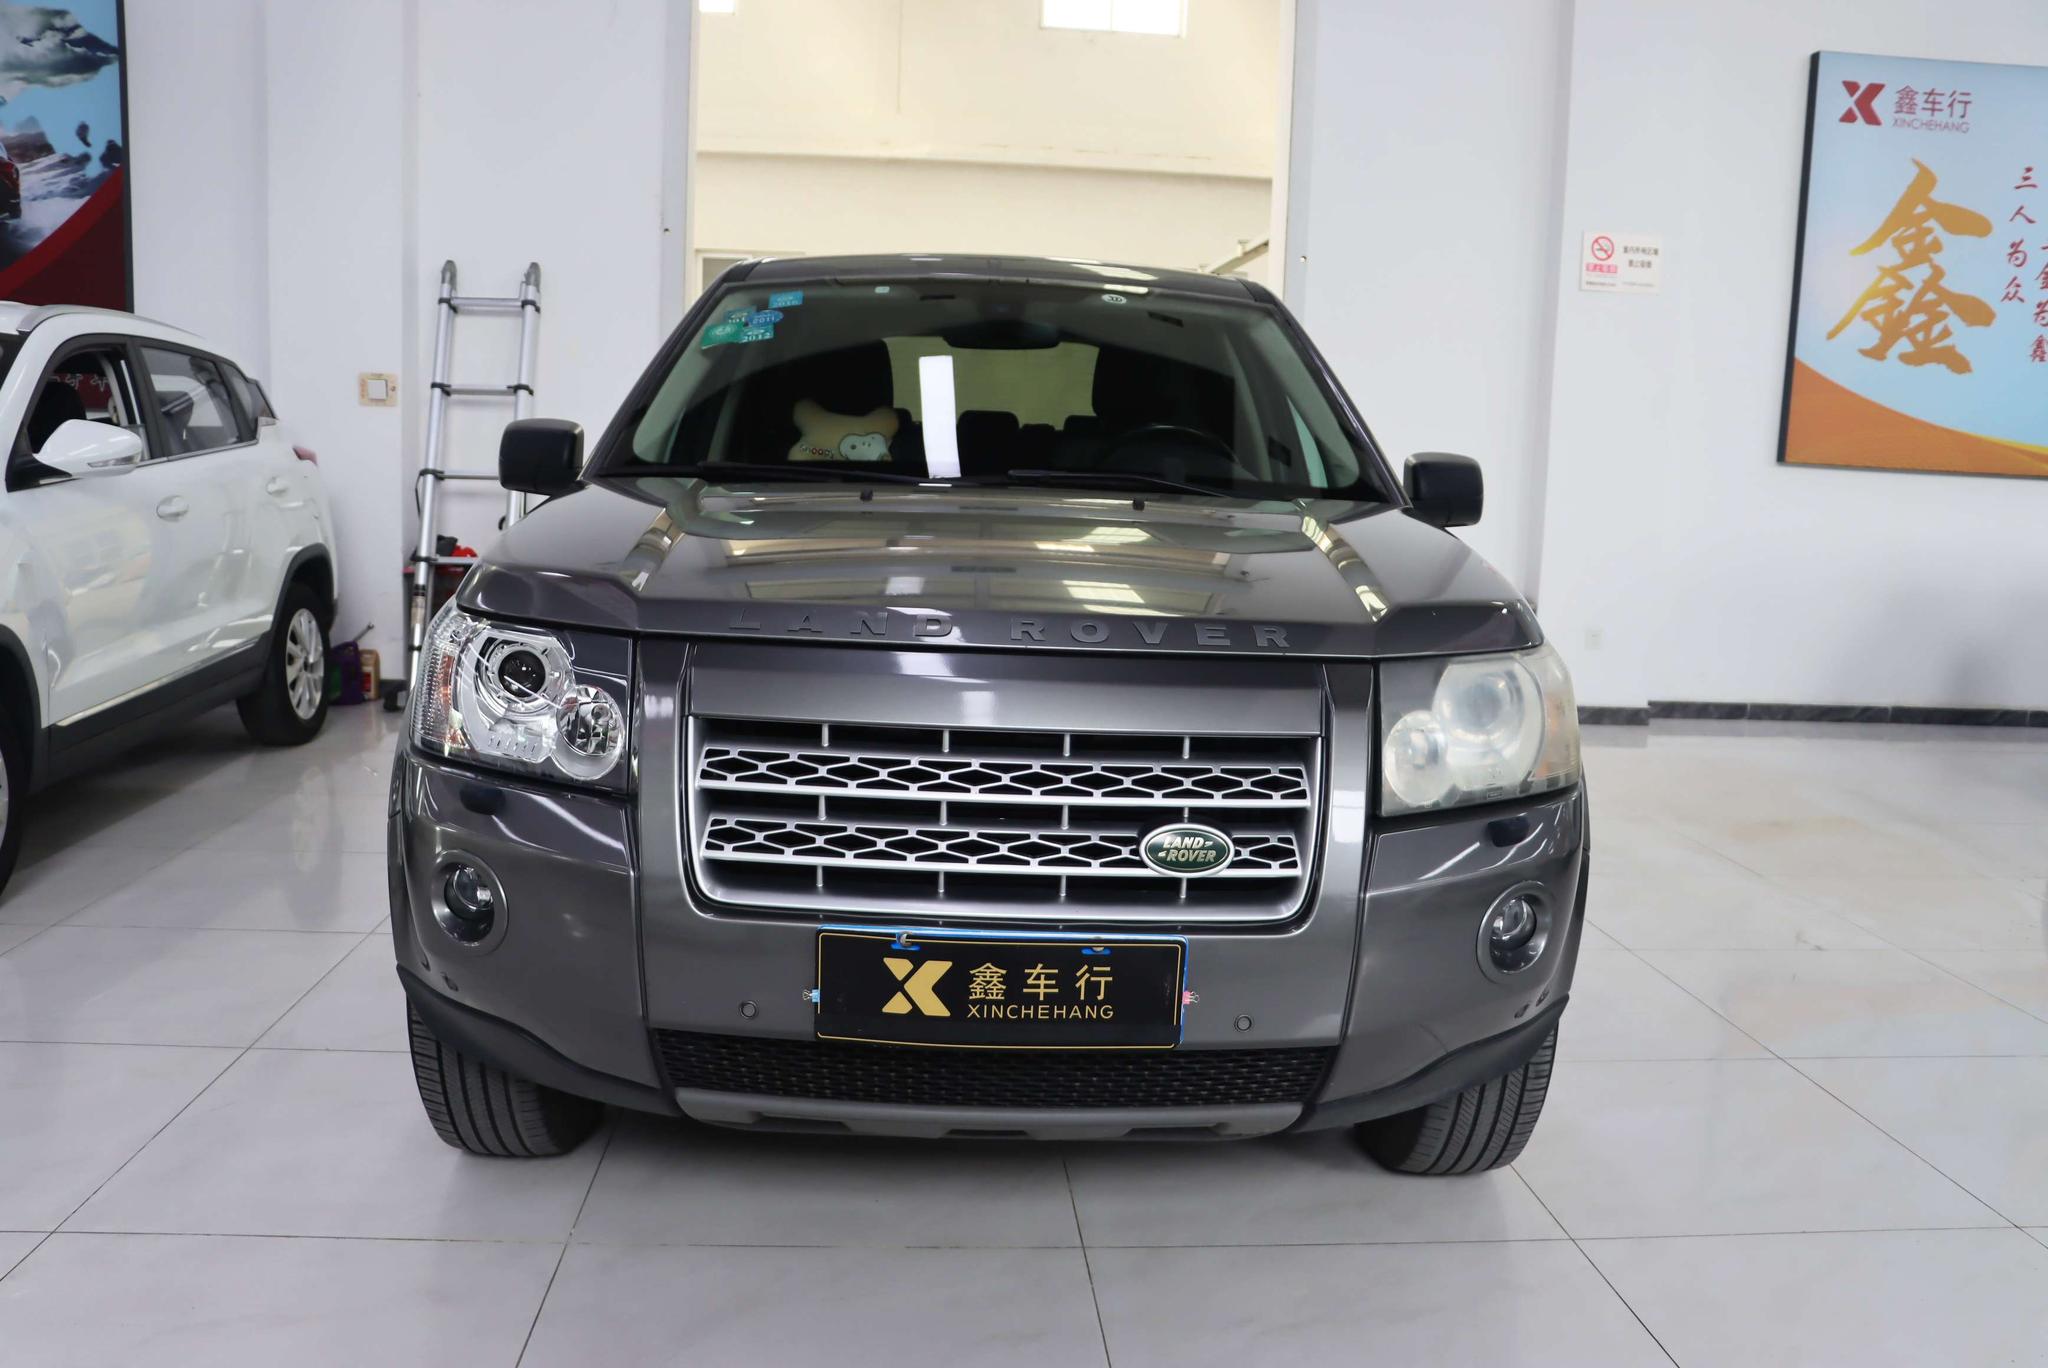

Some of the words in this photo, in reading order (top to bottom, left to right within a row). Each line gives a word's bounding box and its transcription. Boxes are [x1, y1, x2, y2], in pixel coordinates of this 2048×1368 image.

[1893, 85, 1972, 118] 鑫车行
[1892, 117, 1971, 133] XINCHEHANG
[2000, 166, 2038, 303] 三人为众
[729, 607, 953, 638] LAND
[1009, 617, 1291, 648] ROVER
[1163, 836, 1205, 849] LAND
[1166, 849, 1217, 863] ROVER
[967, 962, 1114, 1001] 鑫车行
[966, 1004, 1115, 1020] XINCHEHANG
